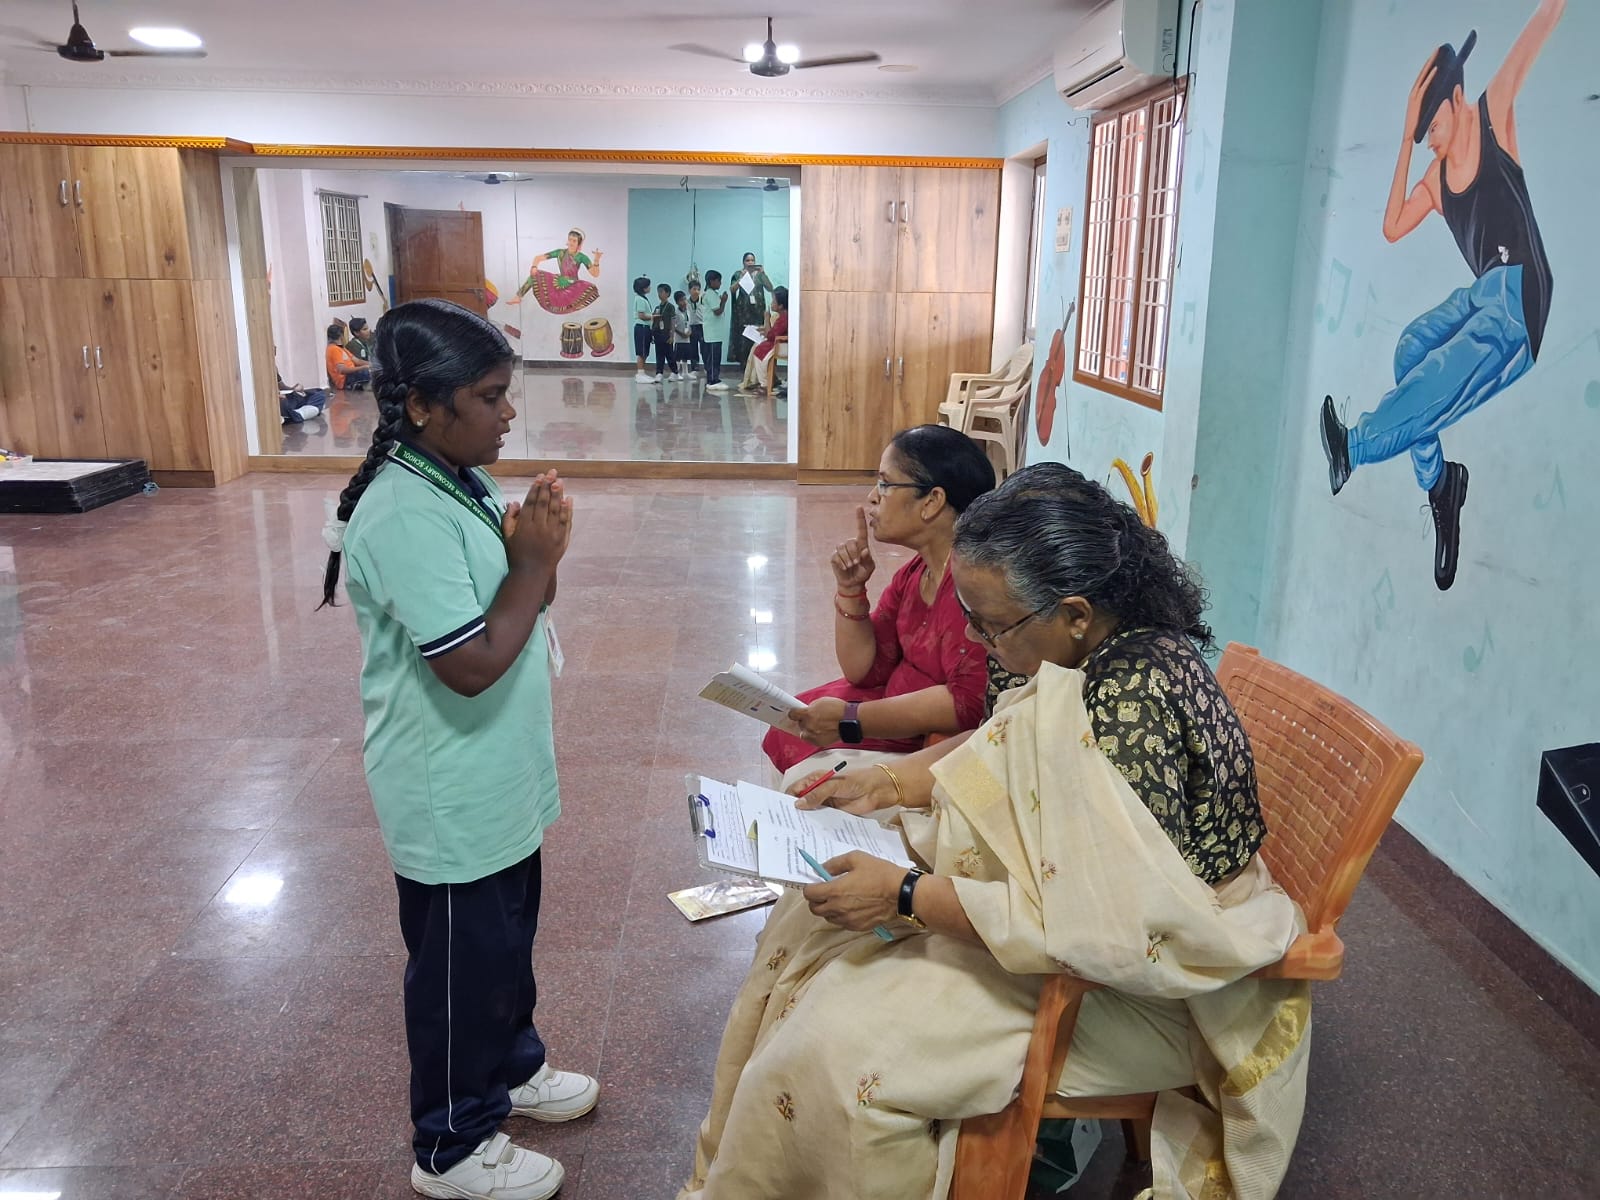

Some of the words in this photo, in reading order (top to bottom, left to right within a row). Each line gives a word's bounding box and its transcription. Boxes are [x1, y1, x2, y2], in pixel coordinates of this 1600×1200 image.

[402, 450, 425, 468] SCHOOL
[423, 465, 456, 491] SECONDARY
[455, 488, 473, 507] SENIOR
